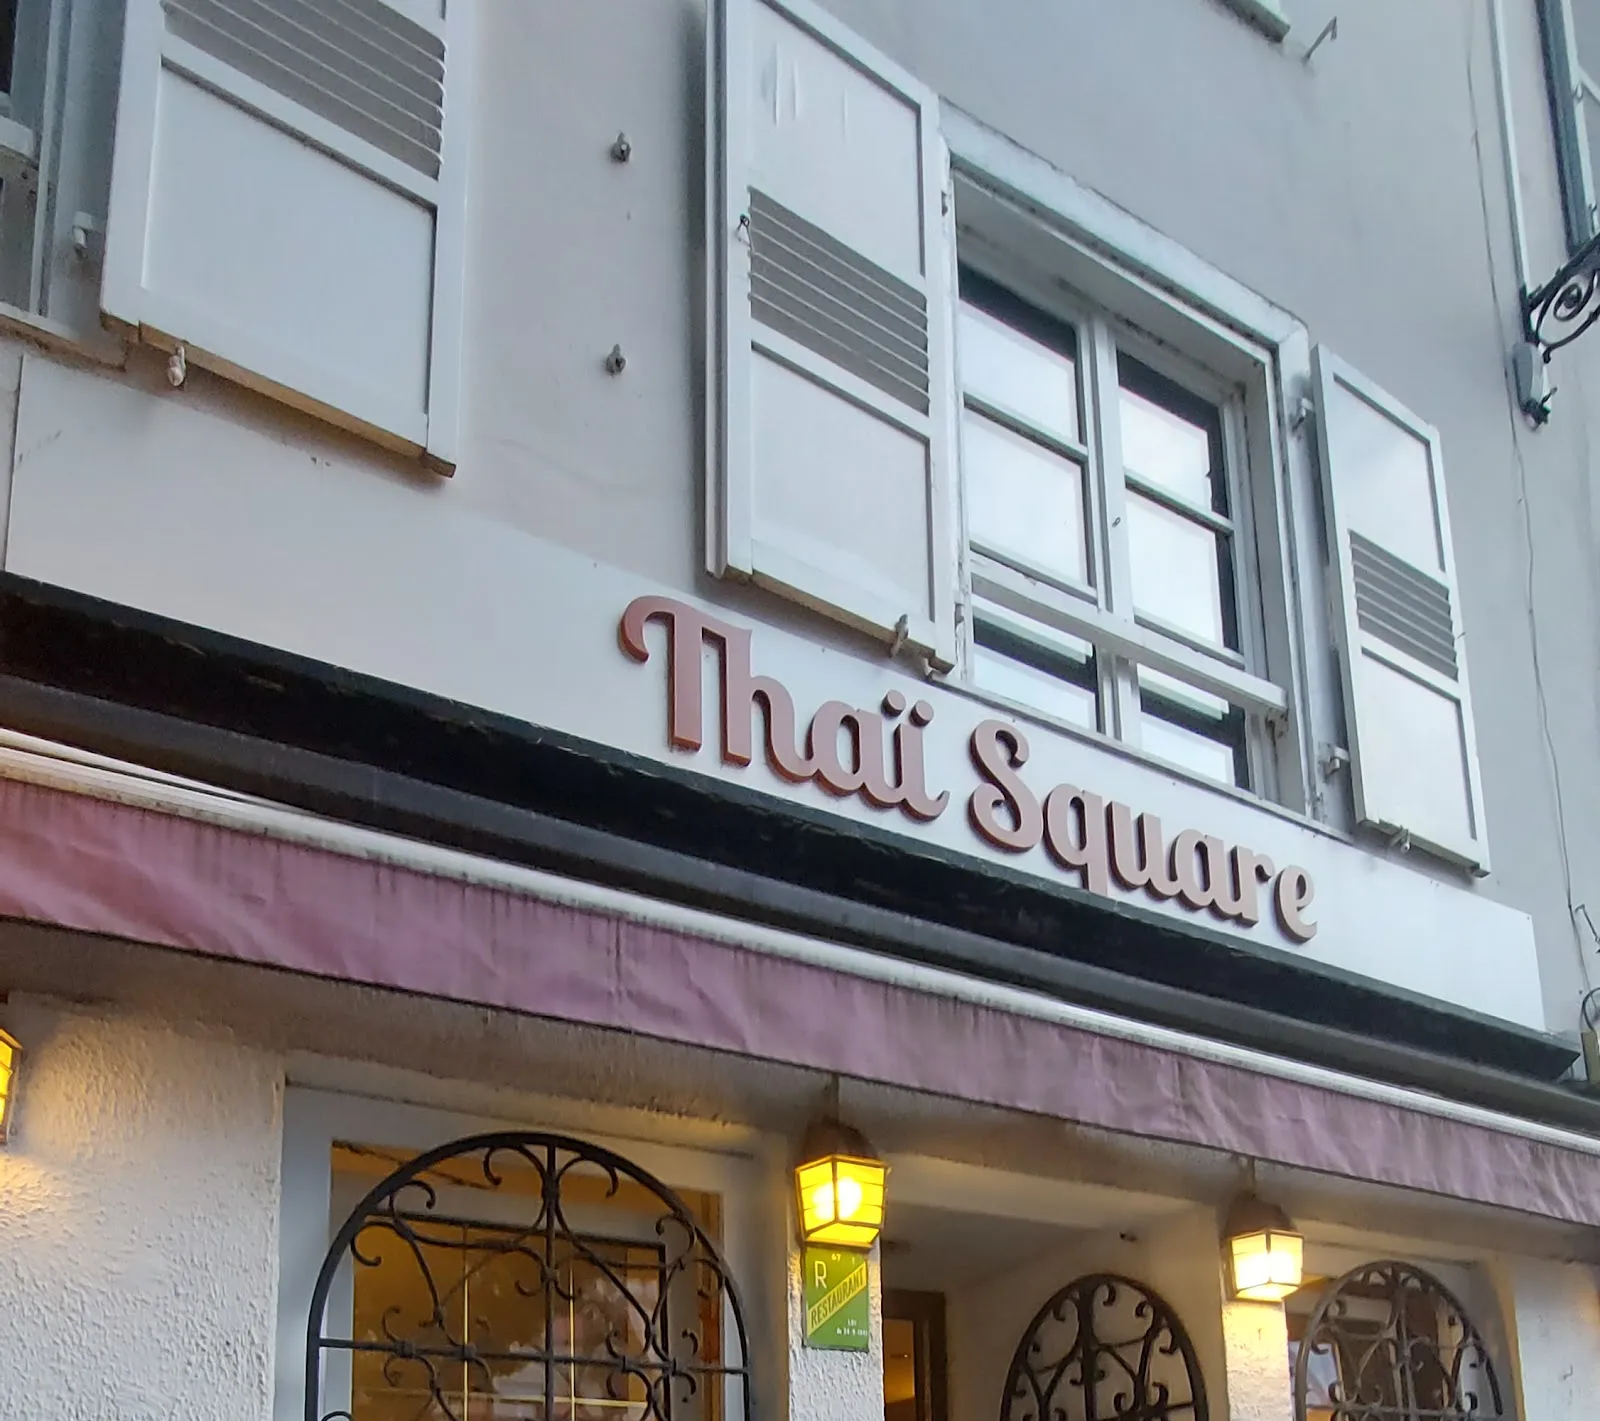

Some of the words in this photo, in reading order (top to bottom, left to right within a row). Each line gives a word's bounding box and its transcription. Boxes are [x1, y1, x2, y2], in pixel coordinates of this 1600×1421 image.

[618, 594, 950, 822] Thaï
[967, 718, 1318, 943] Square
[810, 1267, 864, 1329] RESTAURANT
[814, 1260, 827, 1289] R
